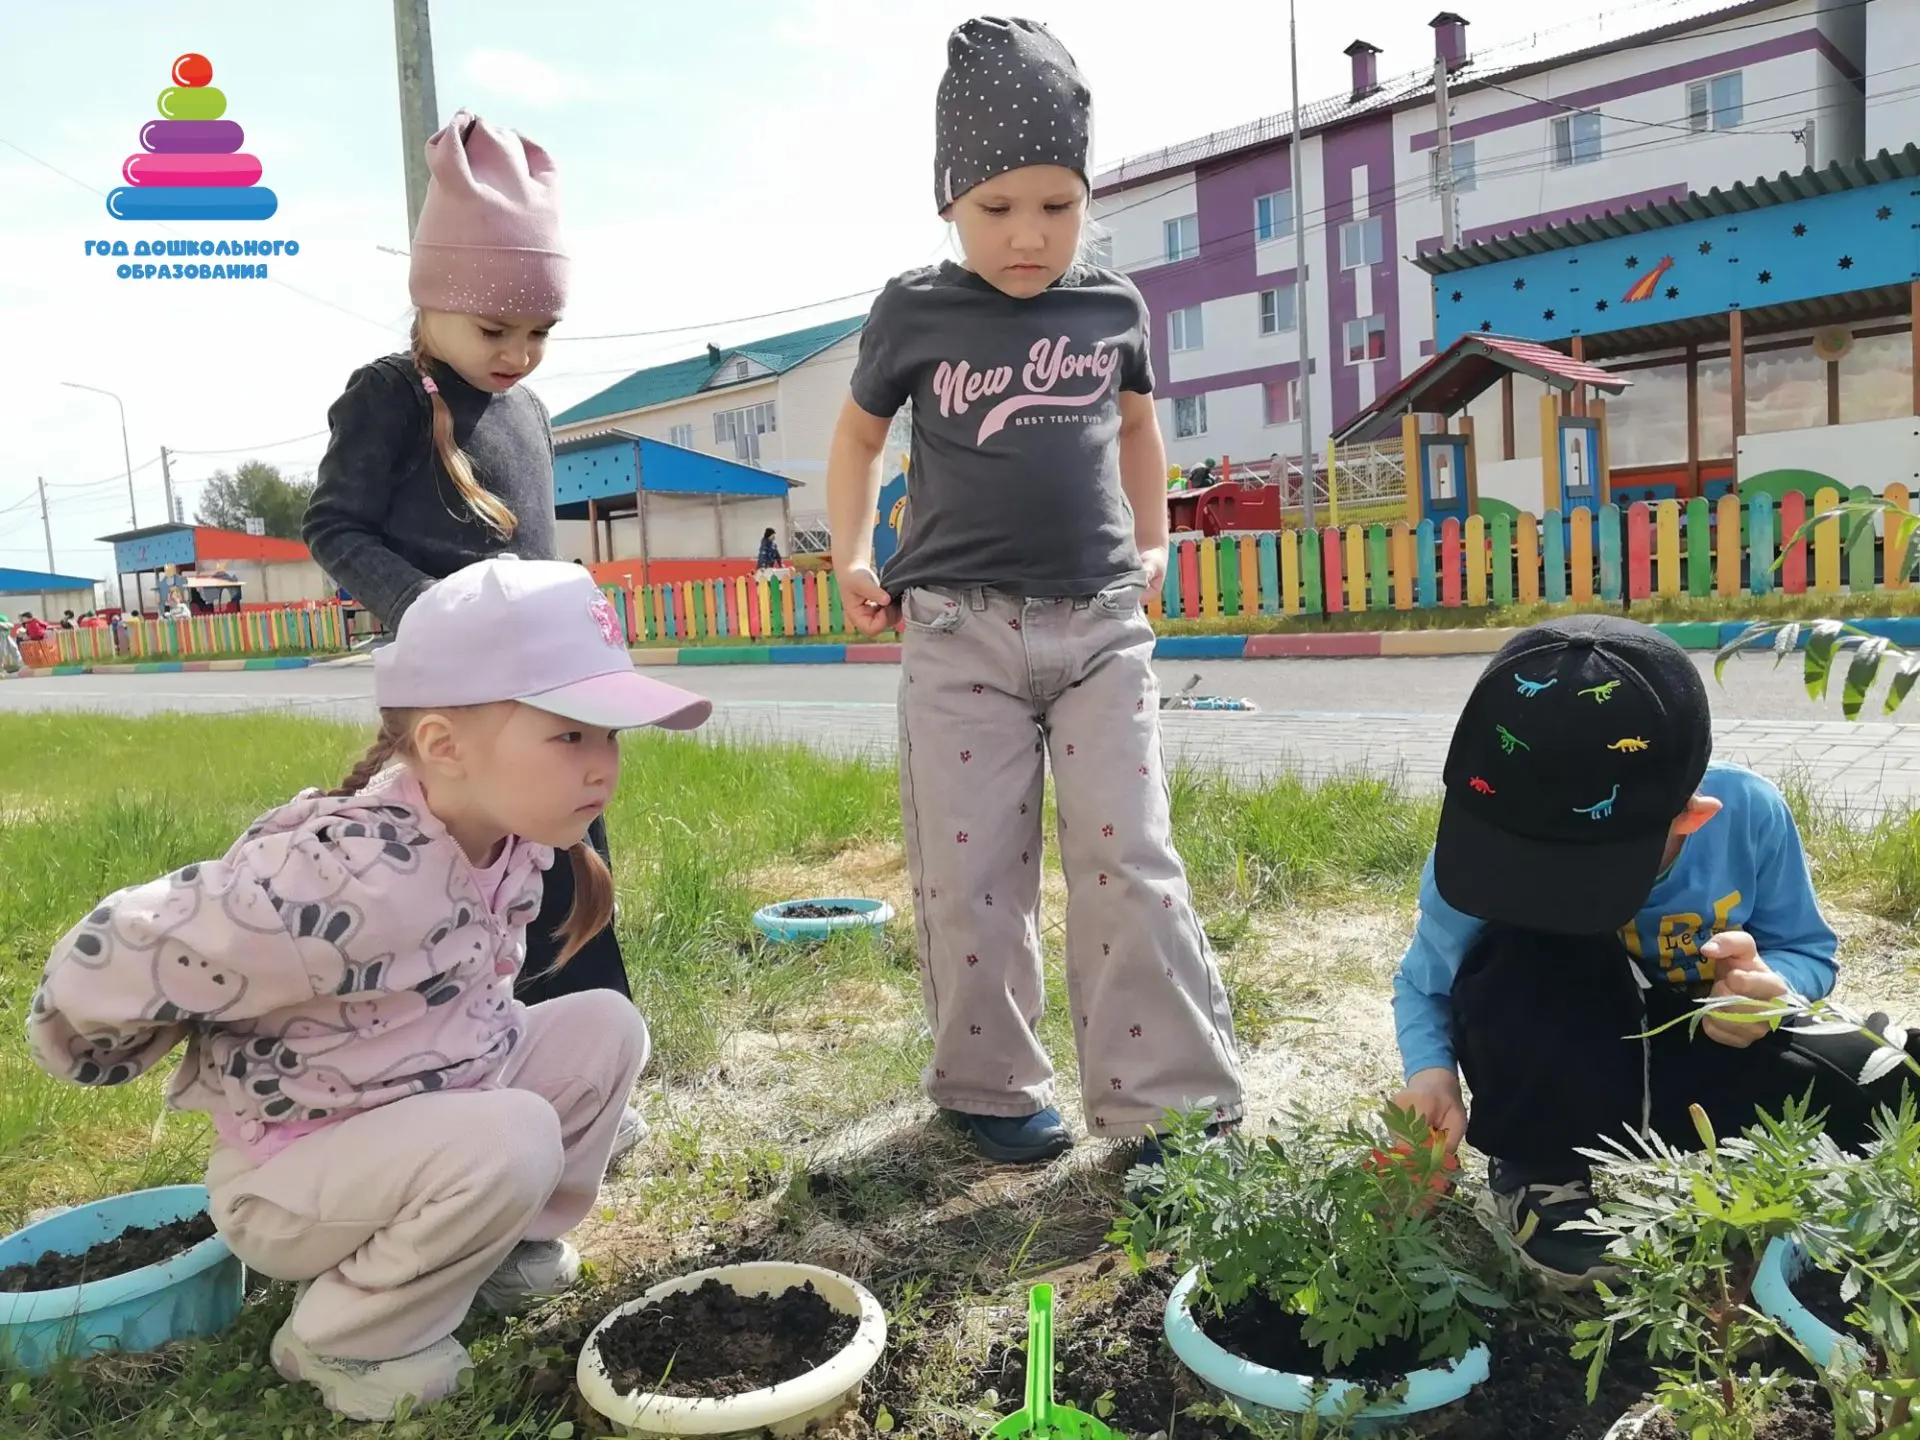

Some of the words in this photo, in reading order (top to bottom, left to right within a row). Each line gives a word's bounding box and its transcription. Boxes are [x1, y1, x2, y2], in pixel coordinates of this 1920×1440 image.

[933, 360, 1013, 418] New
[1015, 417, 1045, 426] BEST
[1050, 415, 1079, 423] TEAM
